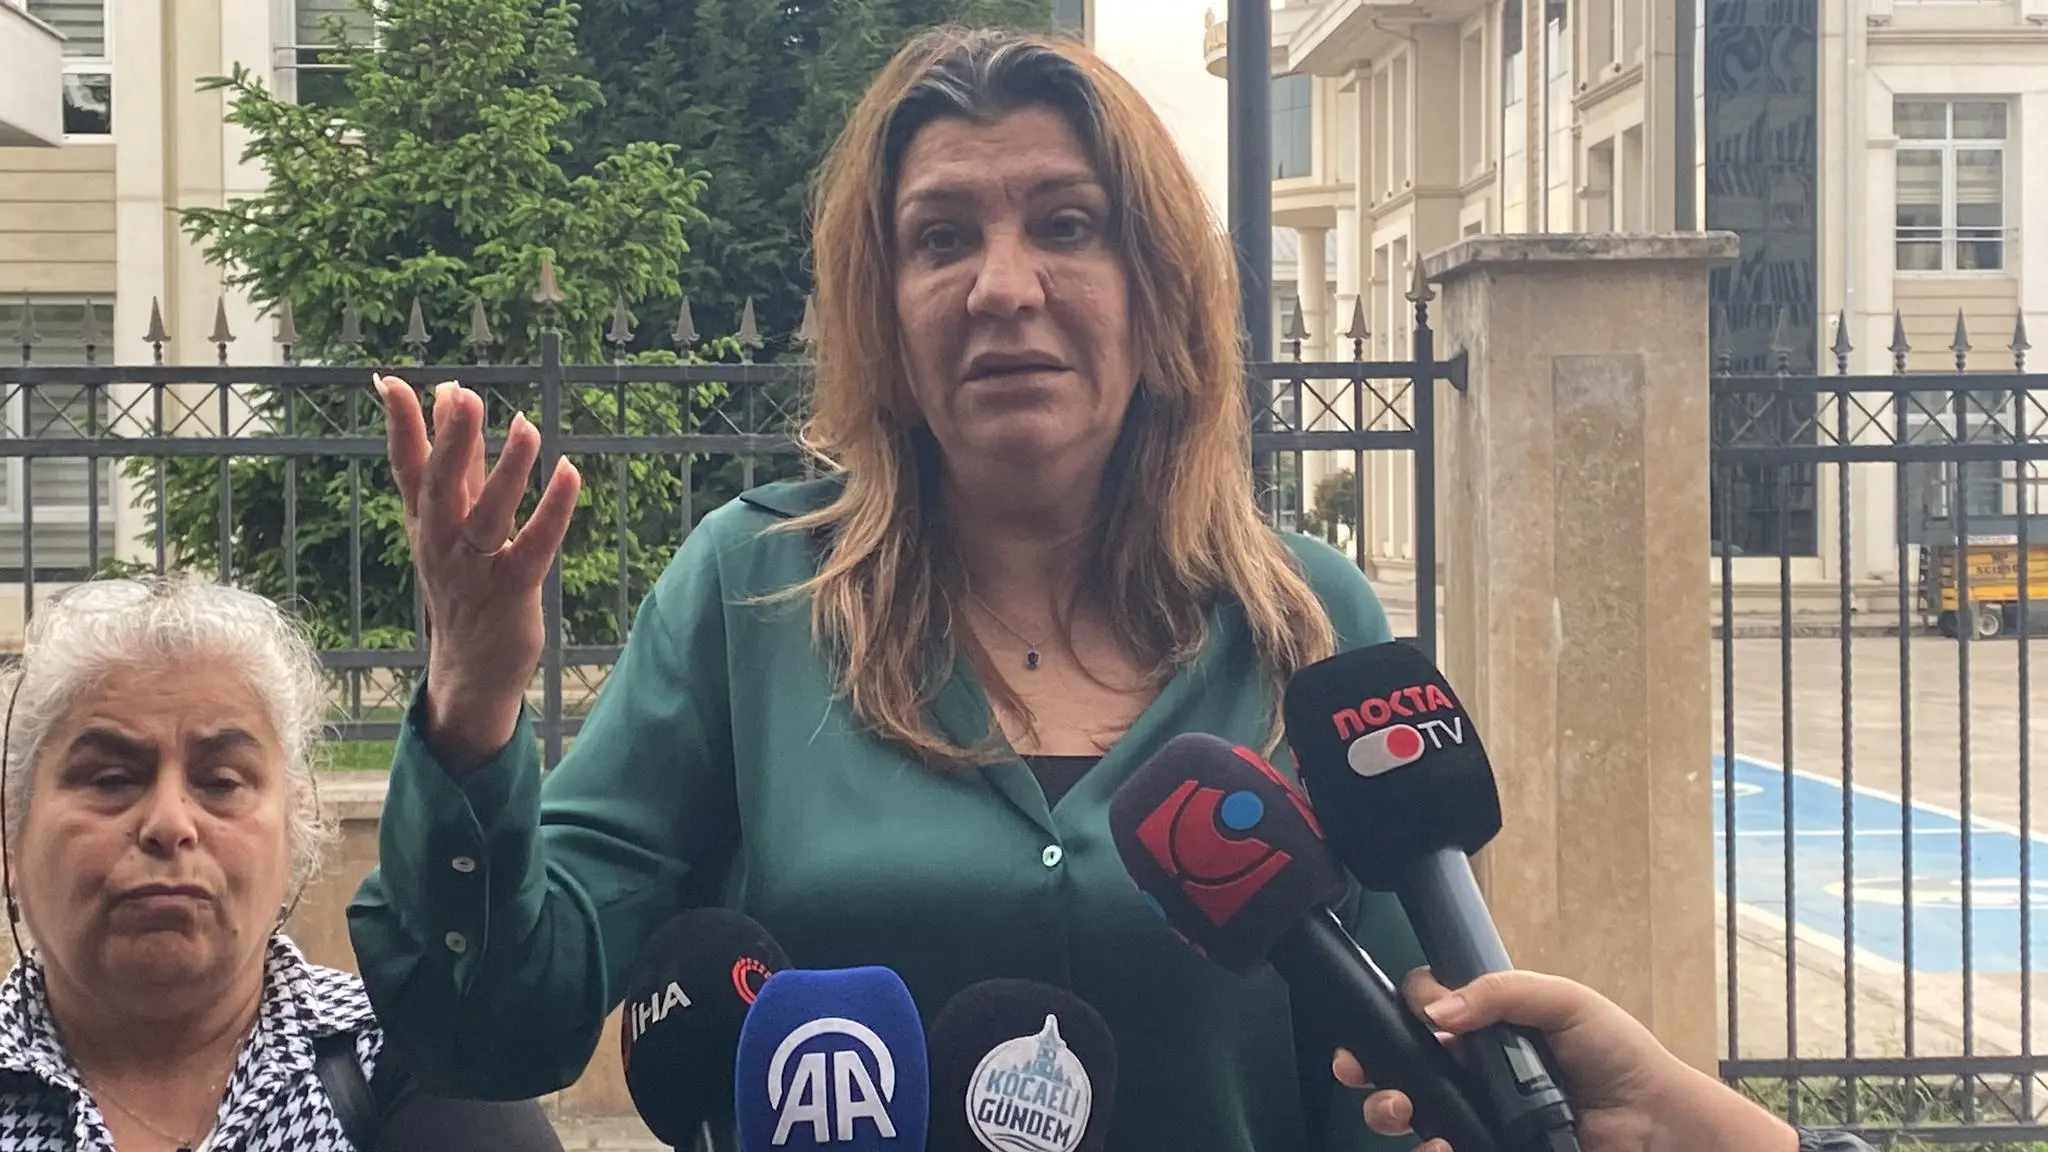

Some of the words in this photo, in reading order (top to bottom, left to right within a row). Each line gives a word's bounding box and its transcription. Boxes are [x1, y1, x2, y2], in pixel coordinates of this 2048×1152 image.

[1417, 716, 1463, 749] TV
[771, 1050, 897, 1145] AA
[978, 1097, 1073, 1147] GÜNDEM
